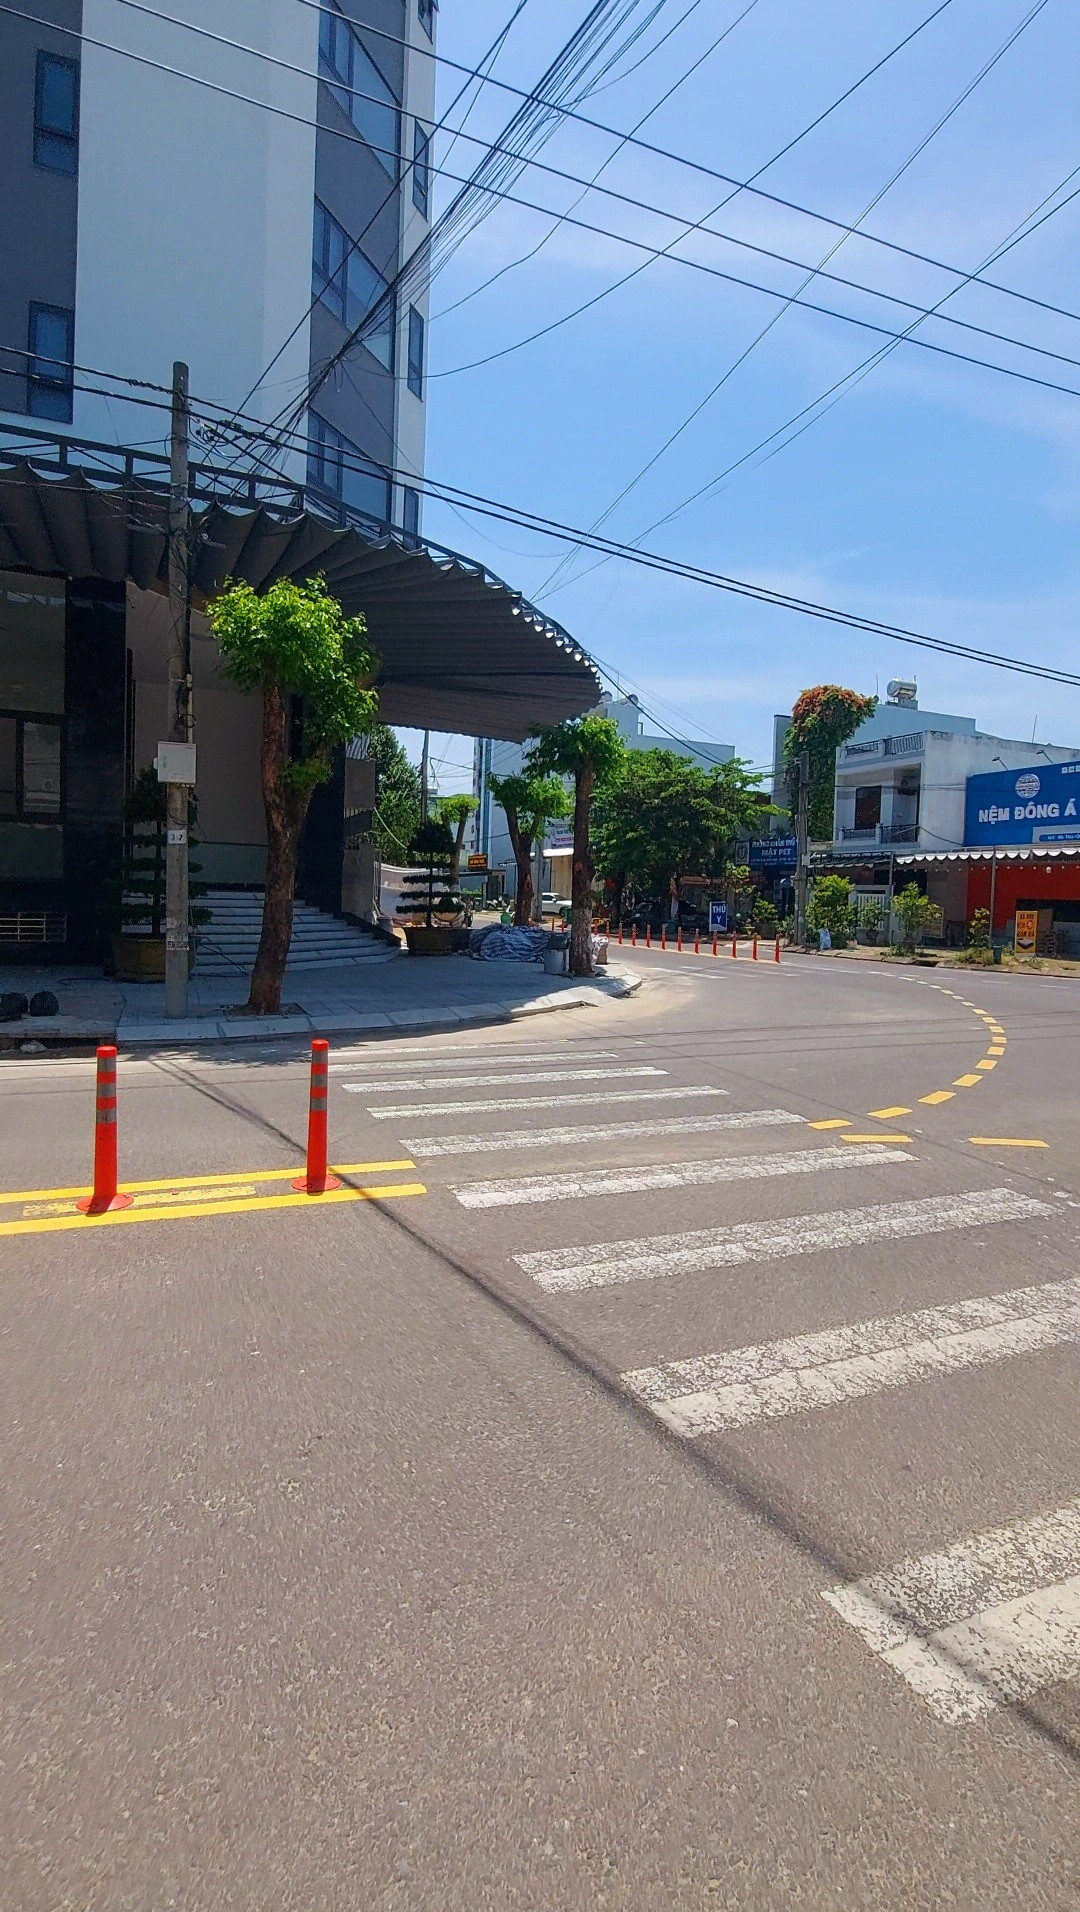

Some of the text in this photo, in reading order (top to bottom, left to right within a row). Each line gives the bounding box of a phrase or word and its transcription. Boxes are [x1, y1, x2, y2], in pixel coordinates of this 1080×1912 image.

[978, 798, 1077, 824] NỆM ĐÔNG Á
[712, 903, 726, 913] THÚ
[716, 915, 722, 923] Y
